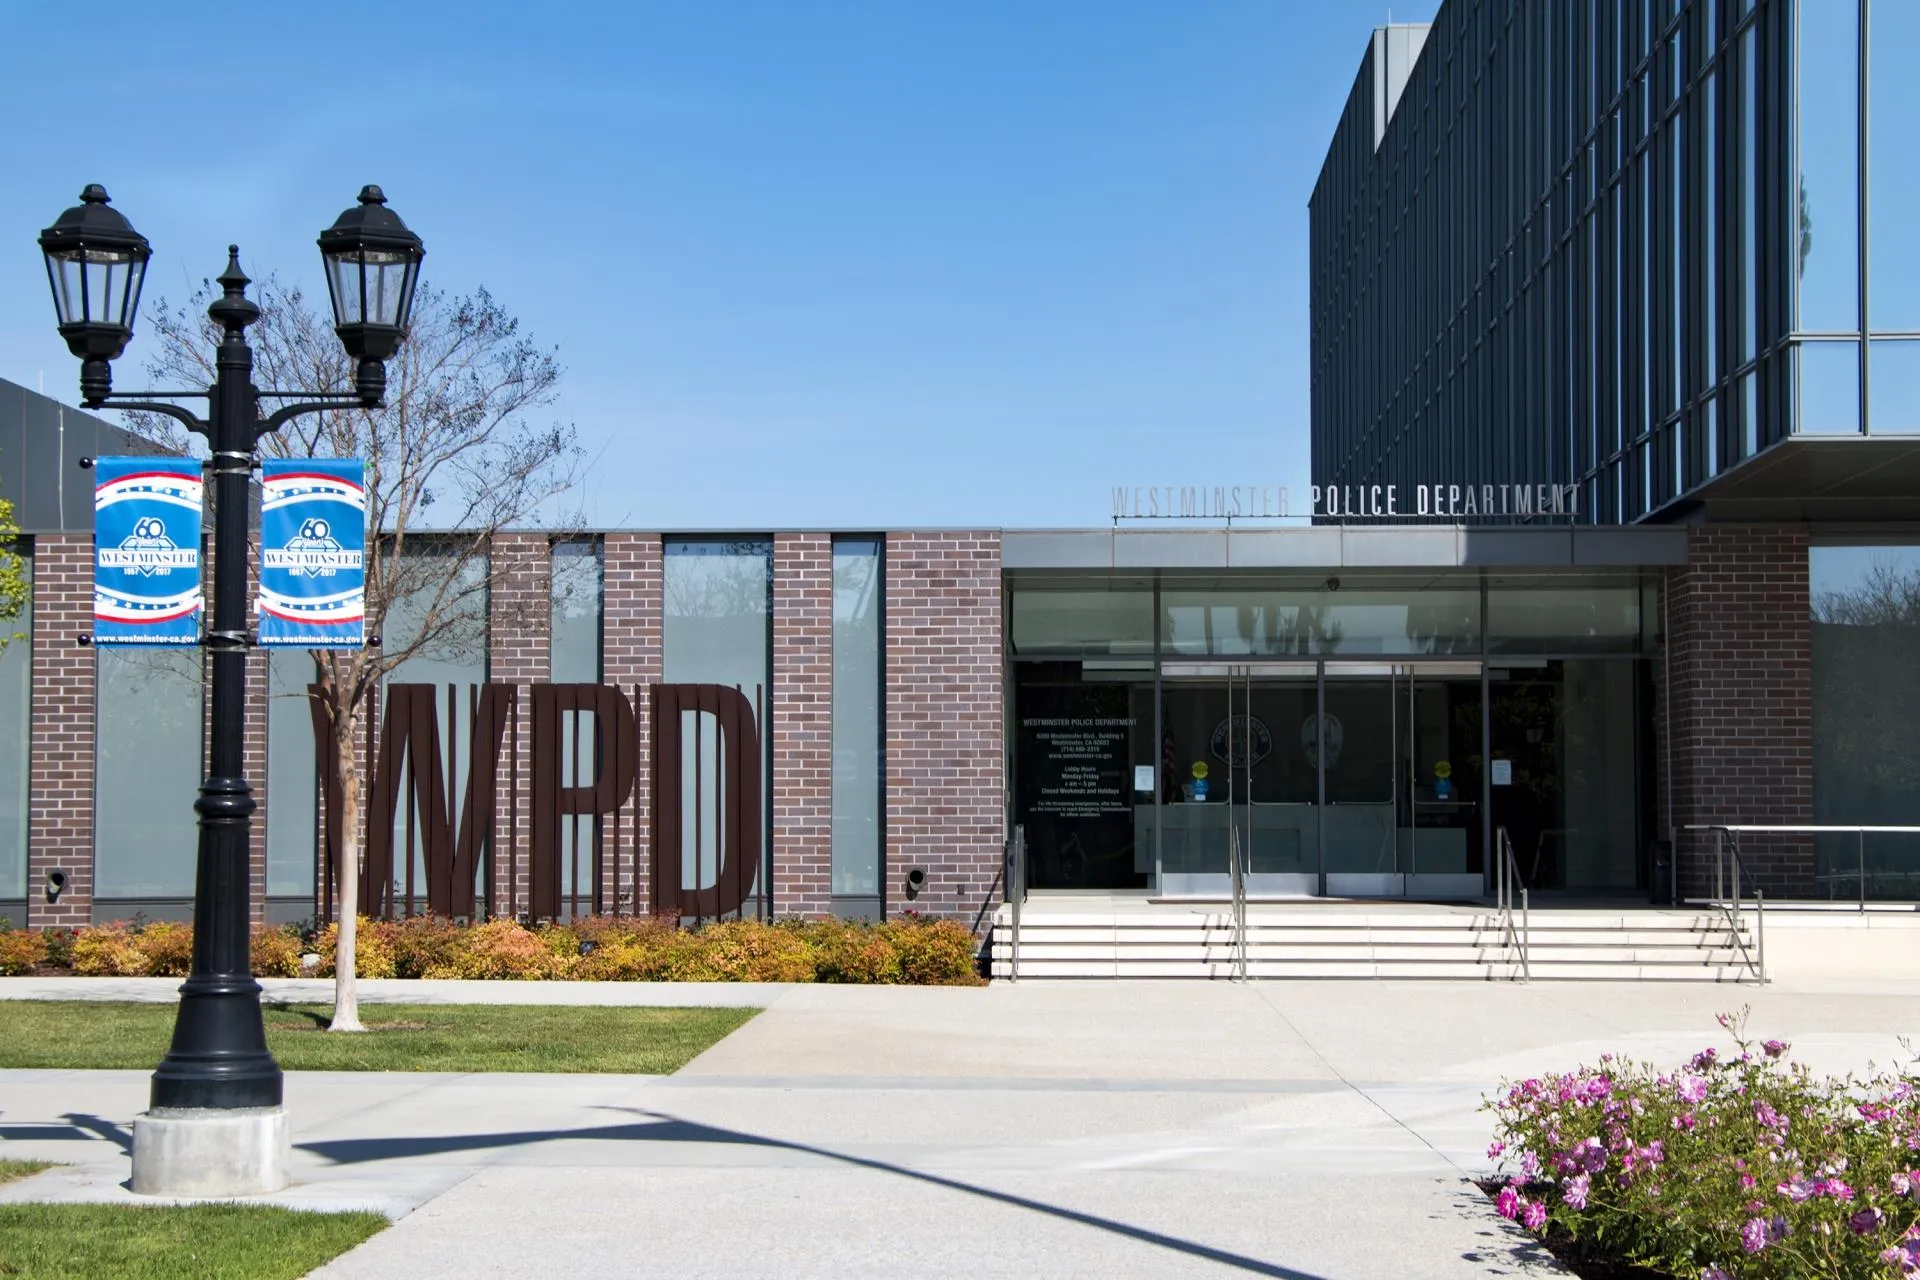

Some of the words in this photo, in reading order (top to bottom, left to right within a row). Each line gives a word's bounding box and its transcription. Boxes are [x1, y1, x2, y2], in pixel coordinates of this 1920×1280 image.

[1111, 486, 1290, 517] WESTMINSTER
[1310, 484, 1397, 516] POLICE
[1416, 484, 1581, 515] DEPARTMENT
[135, 518, 165, 538] 60
[300, 519, 330, 539] 60
[101, 553, 196, 563] WESTMINSTER
[266, 553, 361, 564] WESTMINSTER
[155, 568, 171, 576] 2017
[320, 568, 336, 577] 2017
[96, 634, 196, 644] www.westminster-ca.gov
[262, 635, 361, 645] www.westminster-ca.gov
[1023, 719, 1069, 727] WESTMINSTER
[1071, 719, 1094, 727] POLICE
[1095, 719, 1137, 727] DEPARTMENT
[1098, 788, 1120, 796] Holidays
[307, 683, 761, 918] WPD
